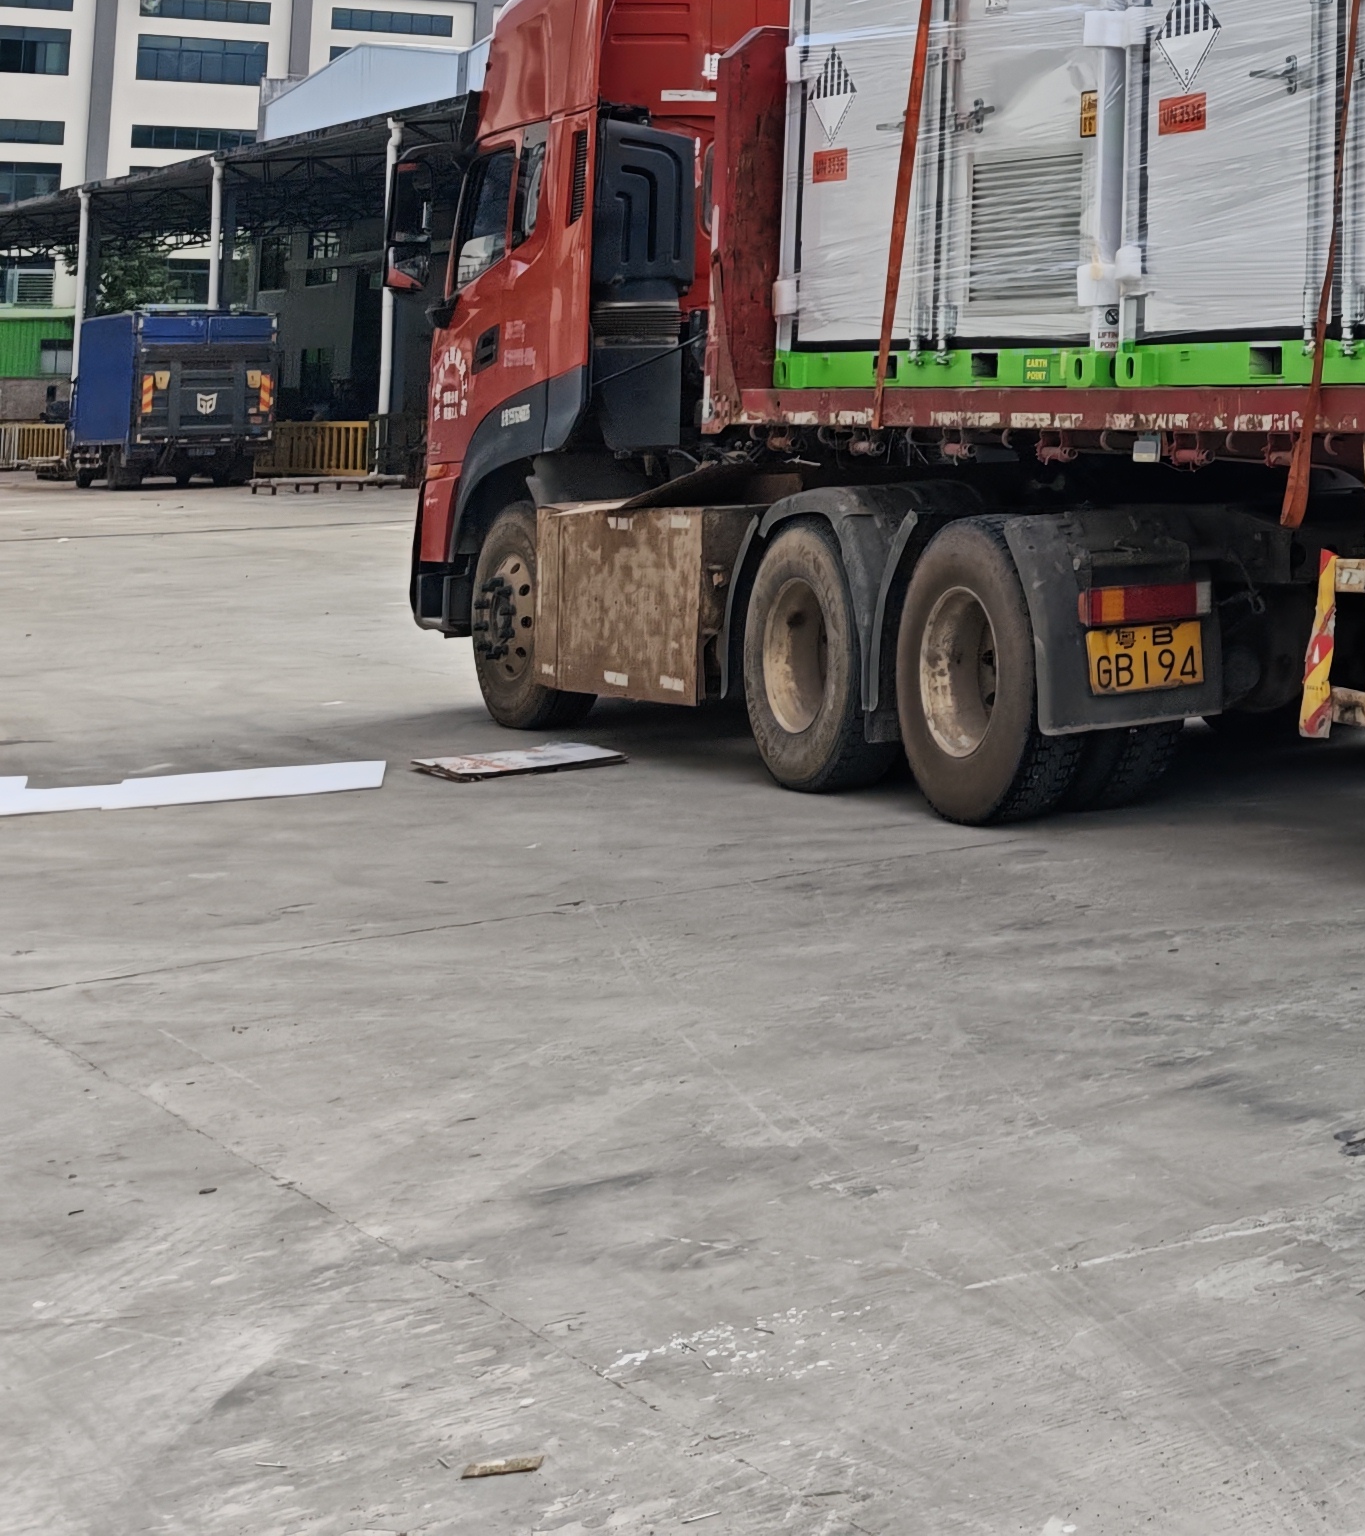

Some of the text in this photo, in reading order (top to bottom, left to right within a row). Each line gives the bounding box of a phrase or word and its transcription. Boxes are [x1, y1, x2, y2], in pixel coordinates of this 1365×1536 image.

[1026, 358, 1047, 368] EARTH
[1026, 371, 1046, 380] POINT
[1097, 645, 1197, 688] GB194
